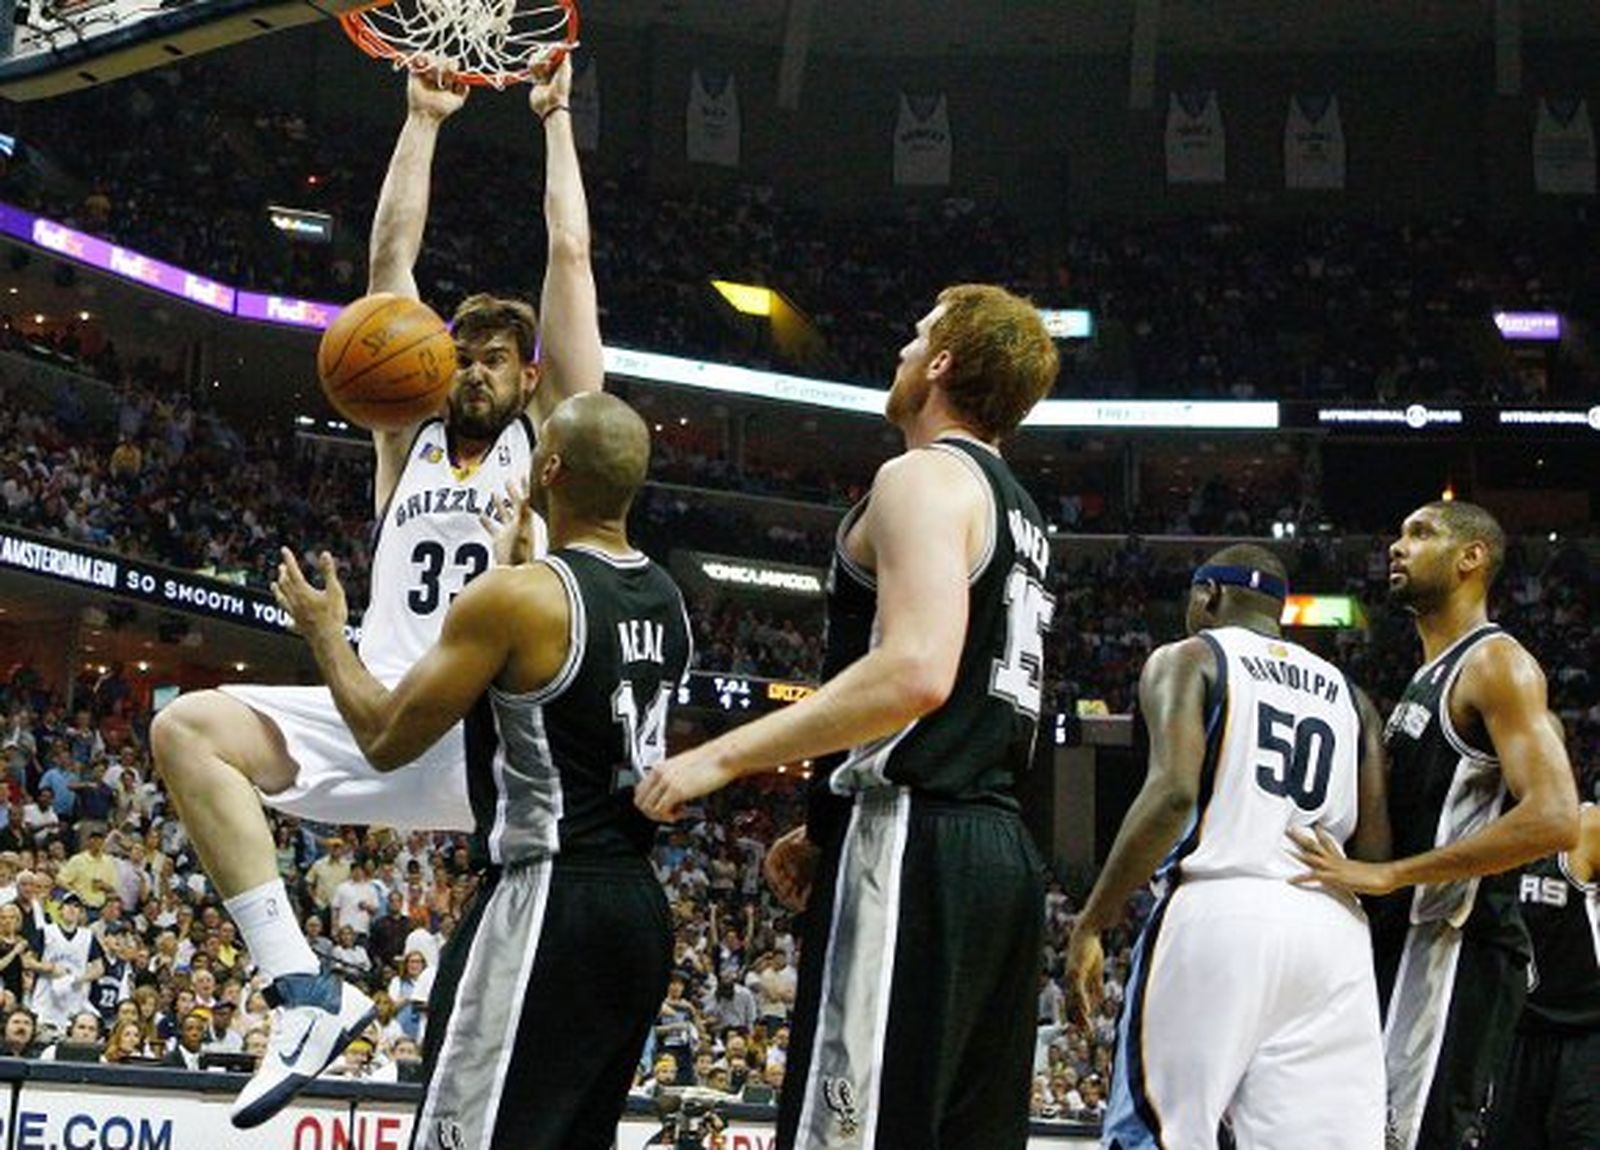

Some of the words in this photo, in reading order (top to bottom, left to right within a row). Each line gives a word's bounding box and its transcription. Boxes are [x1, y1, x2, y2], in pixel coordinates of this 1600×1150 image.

[126, 570, 156, 593] SO
[164, 580, 245, 615] SMOOTH
[617, 619, 665, 665] NEAL
[610, 679, 675, 790] 14
[1255, 699, 1337, 812] 50
[0, 1112, 174, 1150] E.COM
